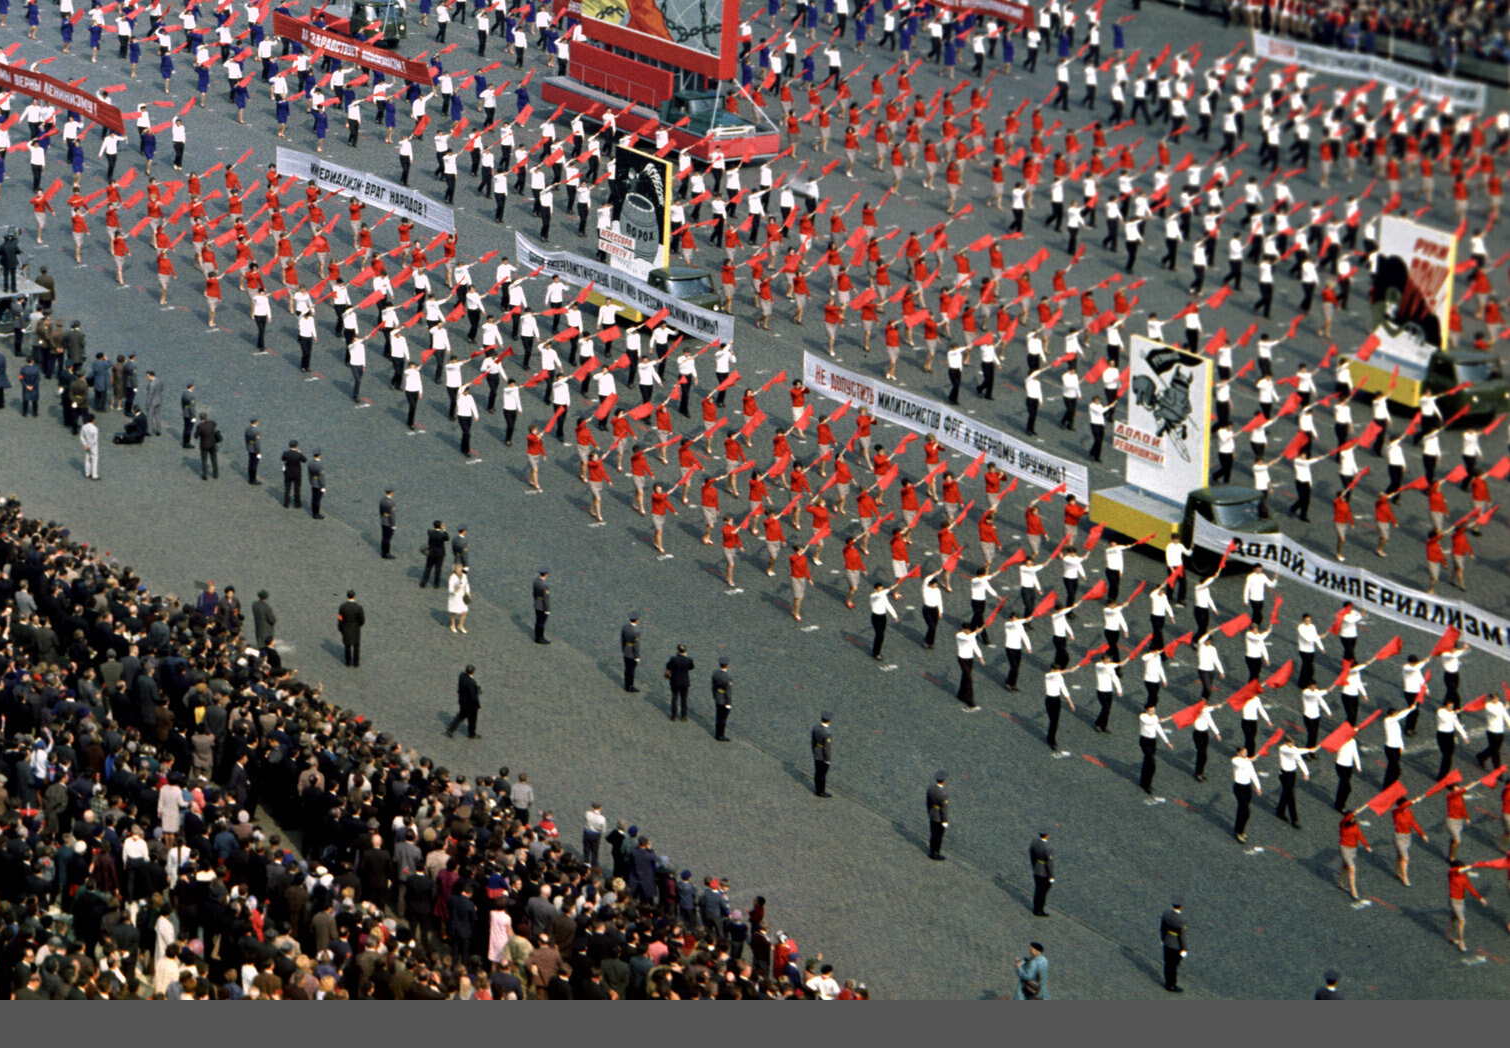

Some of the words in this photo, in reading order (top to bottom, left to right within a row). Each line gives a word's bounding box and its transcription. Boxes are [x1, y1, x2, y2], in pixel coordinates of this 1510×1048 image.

[14, 73, 41, 92] ВЕРНЫ
[43, 81, 98, 116] ЛЕНИНИЗМУ!
[388, 190, 428, 218] НАРОДОВ!
[626, 223, 654, 242] ПОРОХ
[815, 364, 826, 386] НЕ
[830, 372, 874, 405] ДОПУСТИТЬ
[878, 391, 941, 430] МИЛИТАРИСТОВ
[943, 415, 963, 439] ФРГ
[964, 427, 971, 444] К
[973, 431, 1015, 464] ЯДЕРНОМУ
[1019, 451, 1066, 484] ОРУЖИЮ!
[1114, 438, 1165, 464] РЕВАНШИЗМ!
[1233, 537, 1306, 576] ДОЛОЙ
